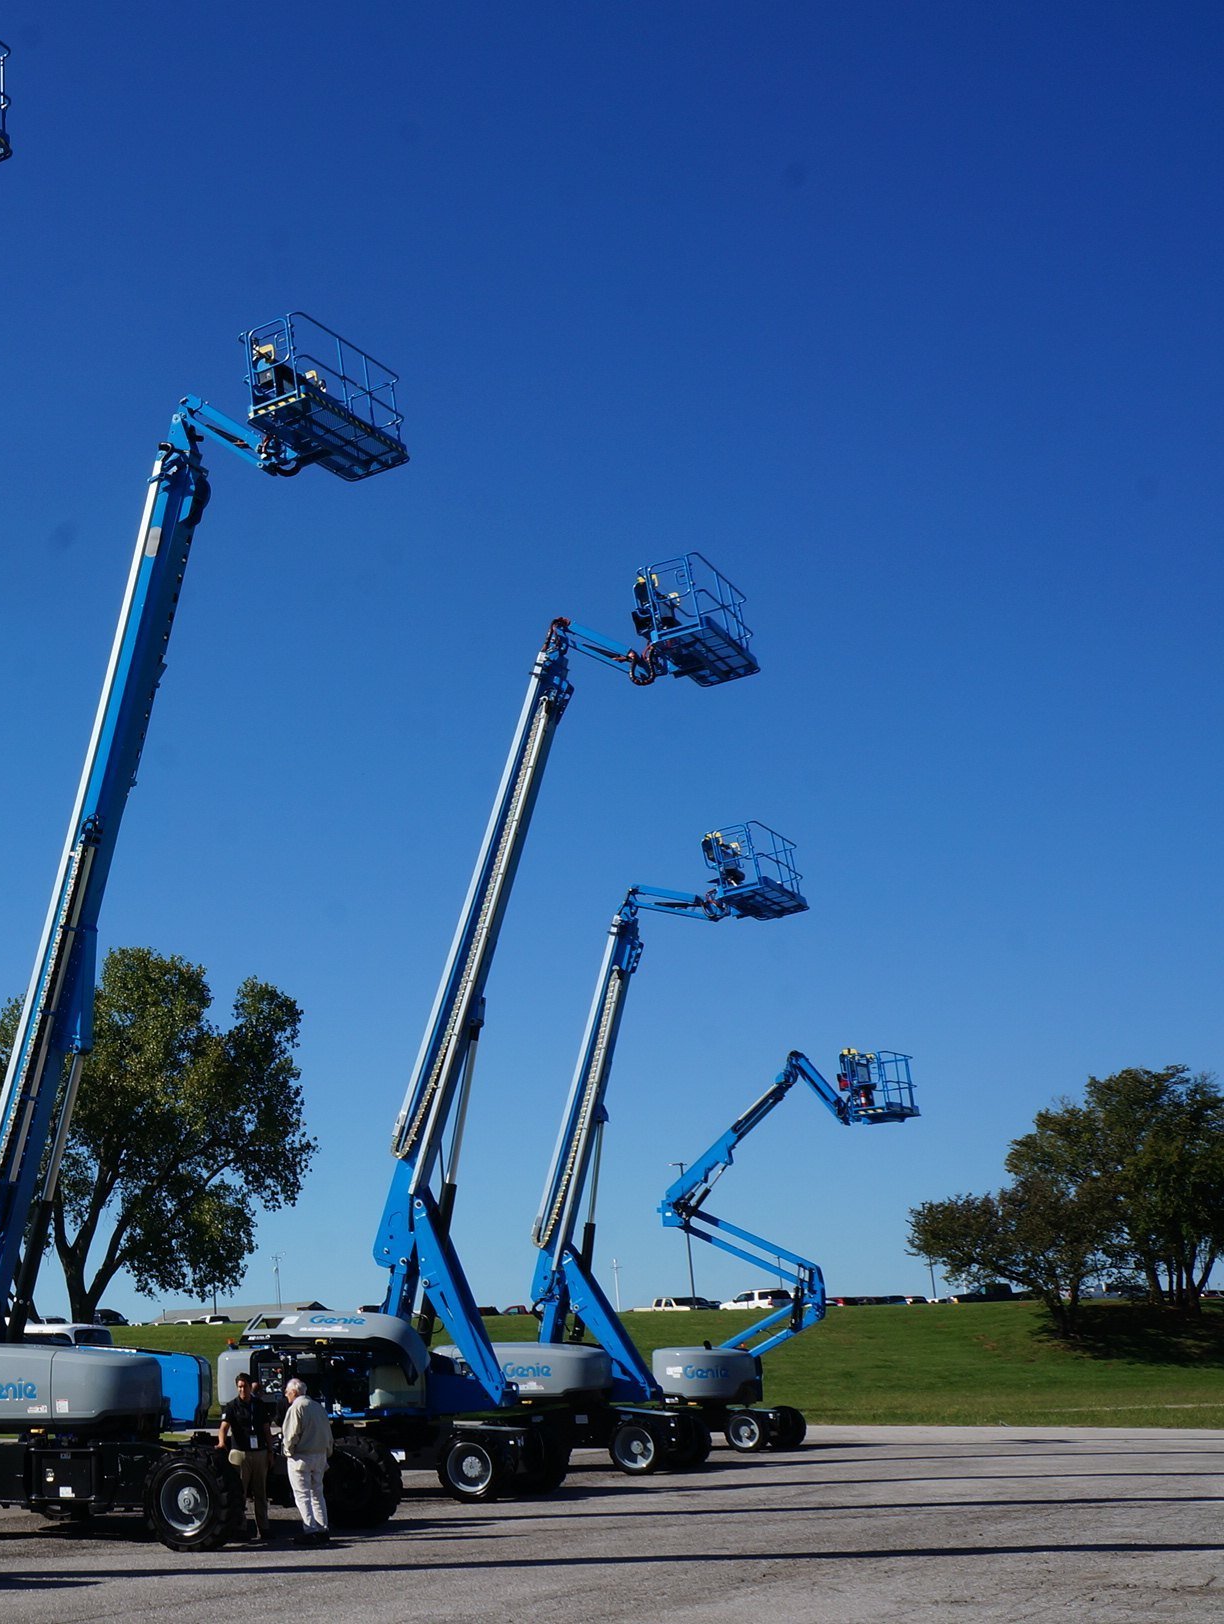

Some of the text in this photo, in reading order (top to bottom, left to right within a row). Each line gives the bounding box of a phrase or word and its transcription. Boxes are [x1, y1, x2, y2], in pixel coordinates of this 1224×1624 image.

[309, 1314, 366, 1326] Genie
[503, 1362, 552, 1378] Genie
[683, 1363, 729, 1380] Genie
